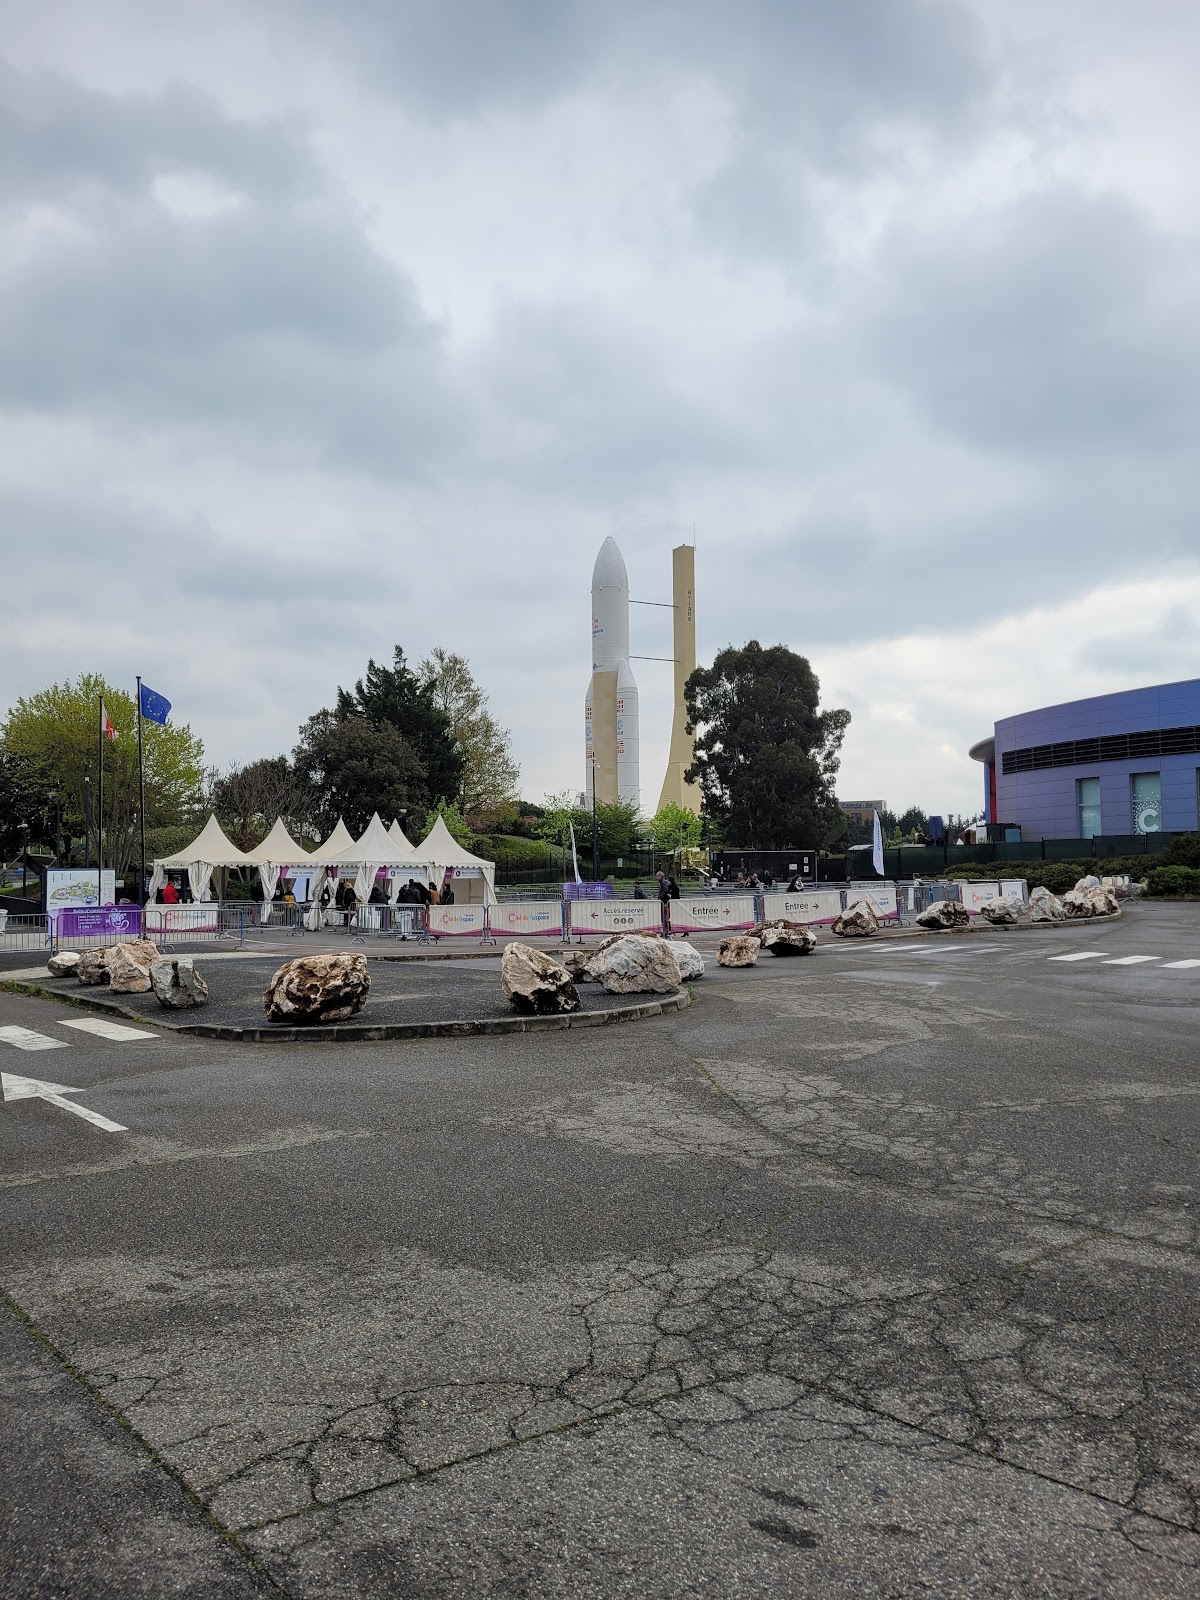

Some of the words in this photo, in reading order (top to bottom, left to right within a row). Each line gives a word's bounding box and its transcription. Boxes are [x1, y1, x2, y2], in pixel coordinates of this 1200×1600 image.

[621, 906, 645, 914] réservé
[692, 906, 719, 915] Entrée
[785, 901, 809, 911] Entrée
